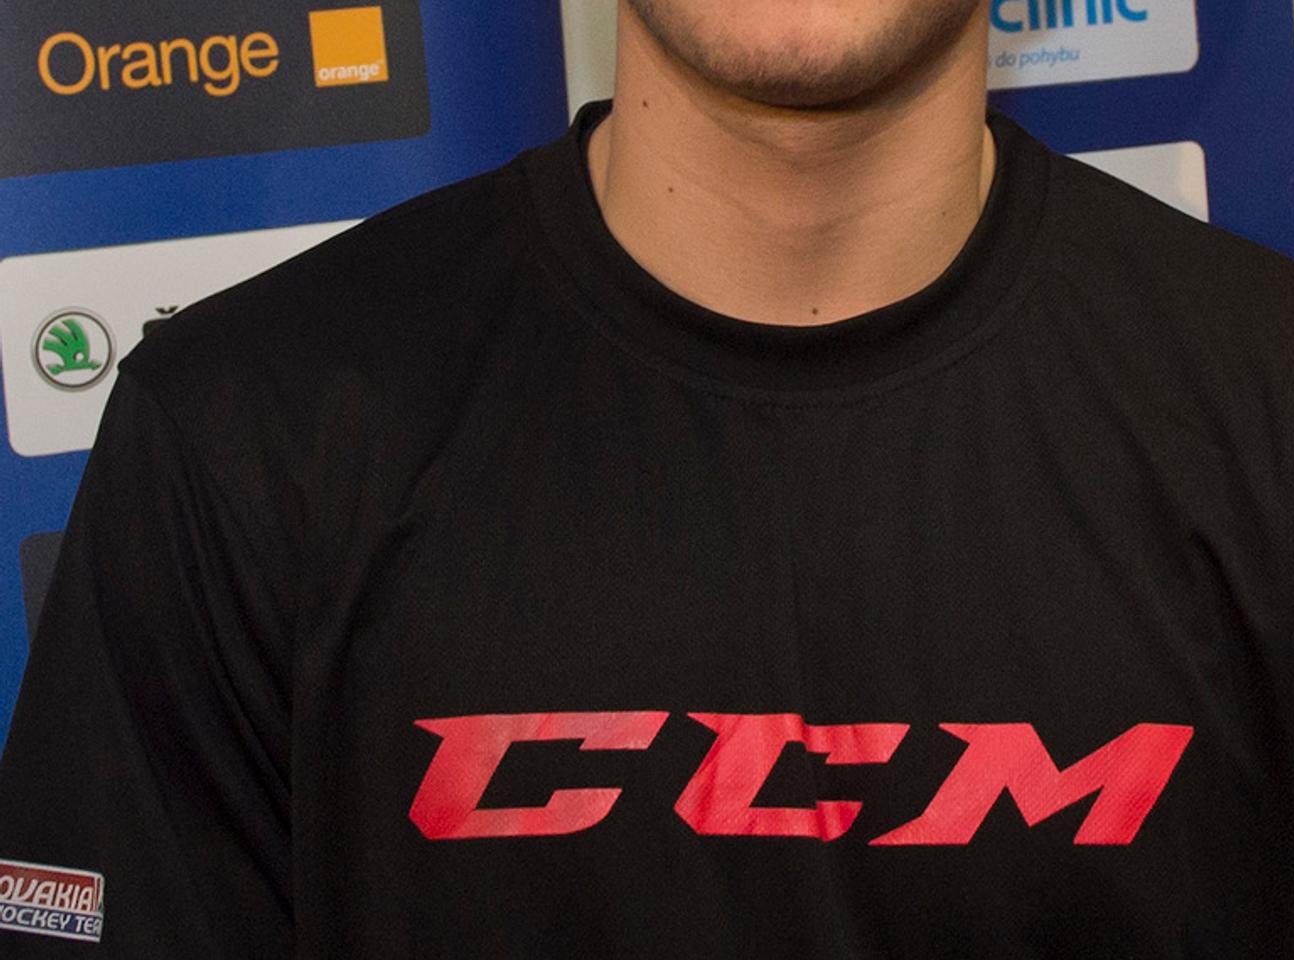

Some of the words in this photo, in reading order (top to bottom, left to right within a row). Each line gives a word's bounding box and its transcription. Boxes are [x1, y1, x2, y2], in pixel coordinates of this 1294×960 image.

[38, 31, 280, 97] Orange
[319, 63, 380, 83] orange
[995, 50, 1017, 68] do
[1019, 46, 1081, 69] pohybu
[407, 710, 1195, 846] CCM
